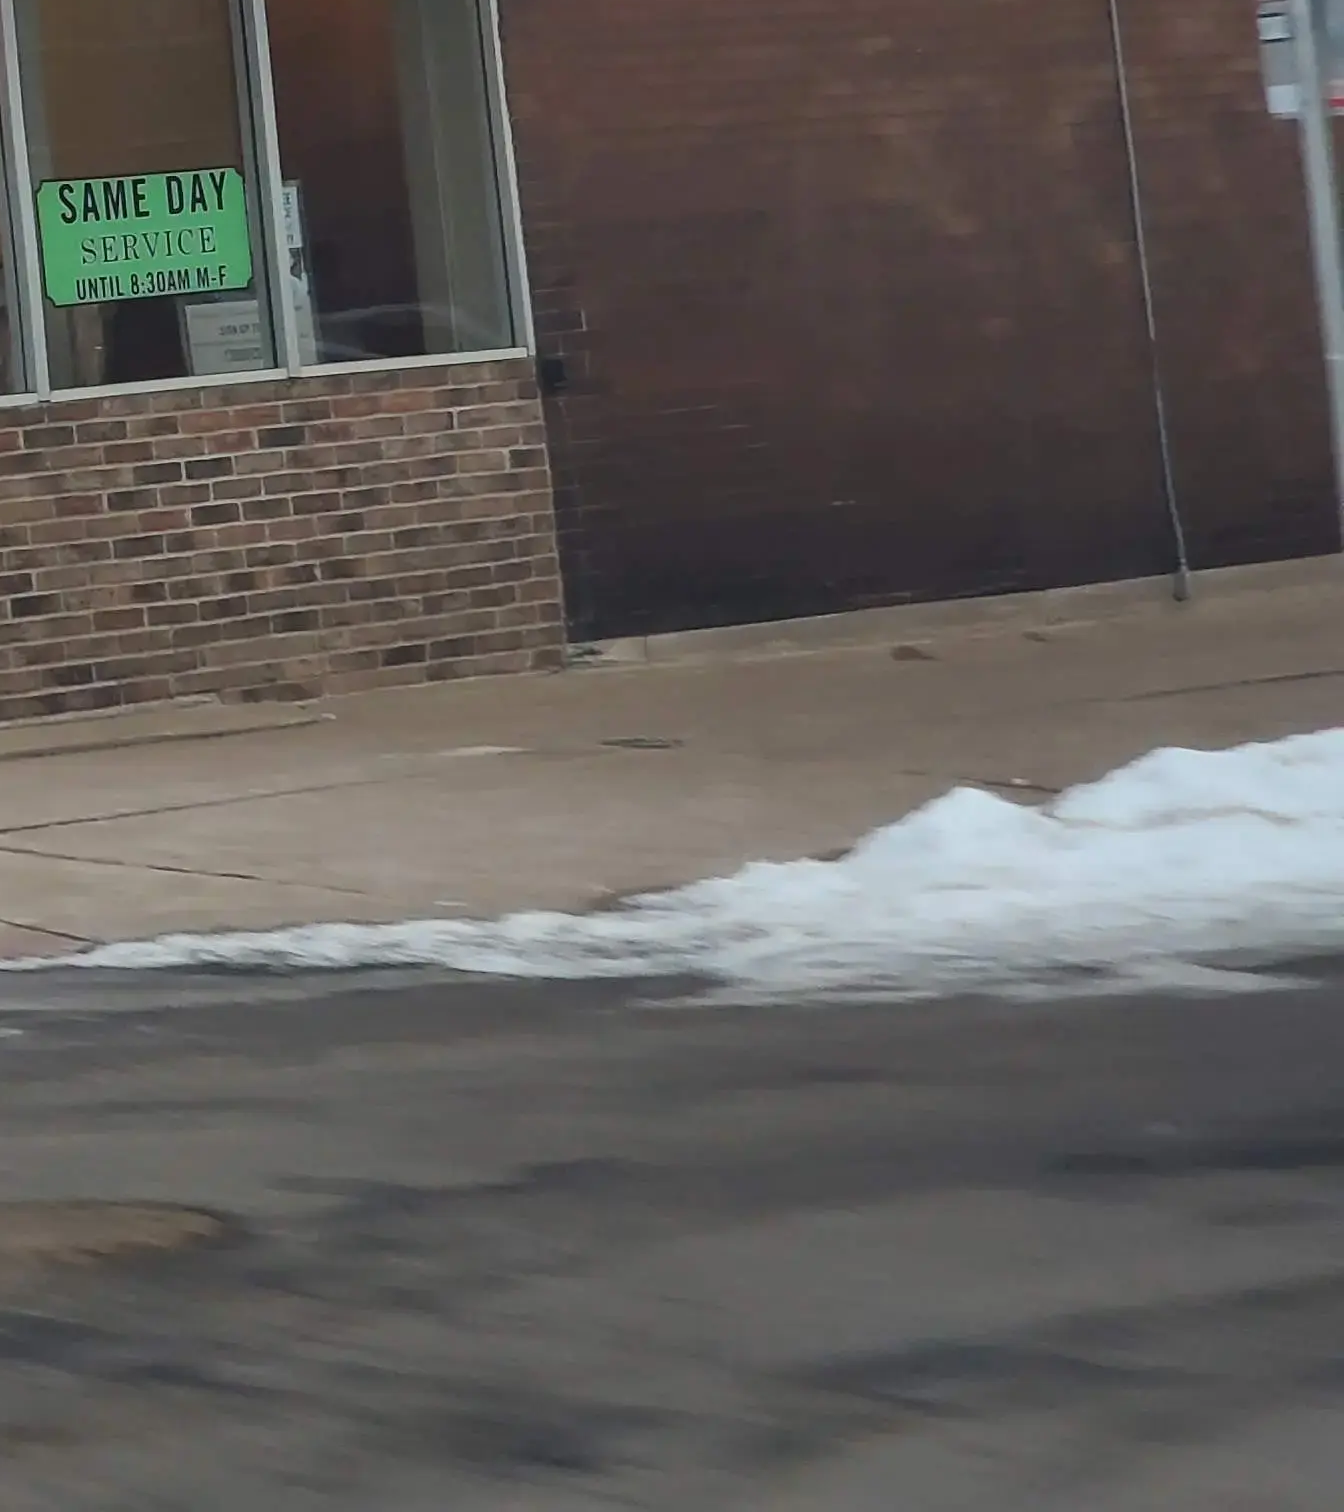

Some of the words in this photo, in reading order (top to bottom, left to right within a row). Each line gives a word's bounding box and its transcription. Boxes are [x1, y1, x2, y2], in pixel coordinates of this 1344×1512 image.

[58, 177, 151, 225] SAME
[165, 170, 227, 215] DAY
[79, 225, 217, 266] SERVICE
[75, 276, 124, 301] UNTIL
[130, 268, 191, 296] 8:30AM
[196, 264, 228, 288] M-F
